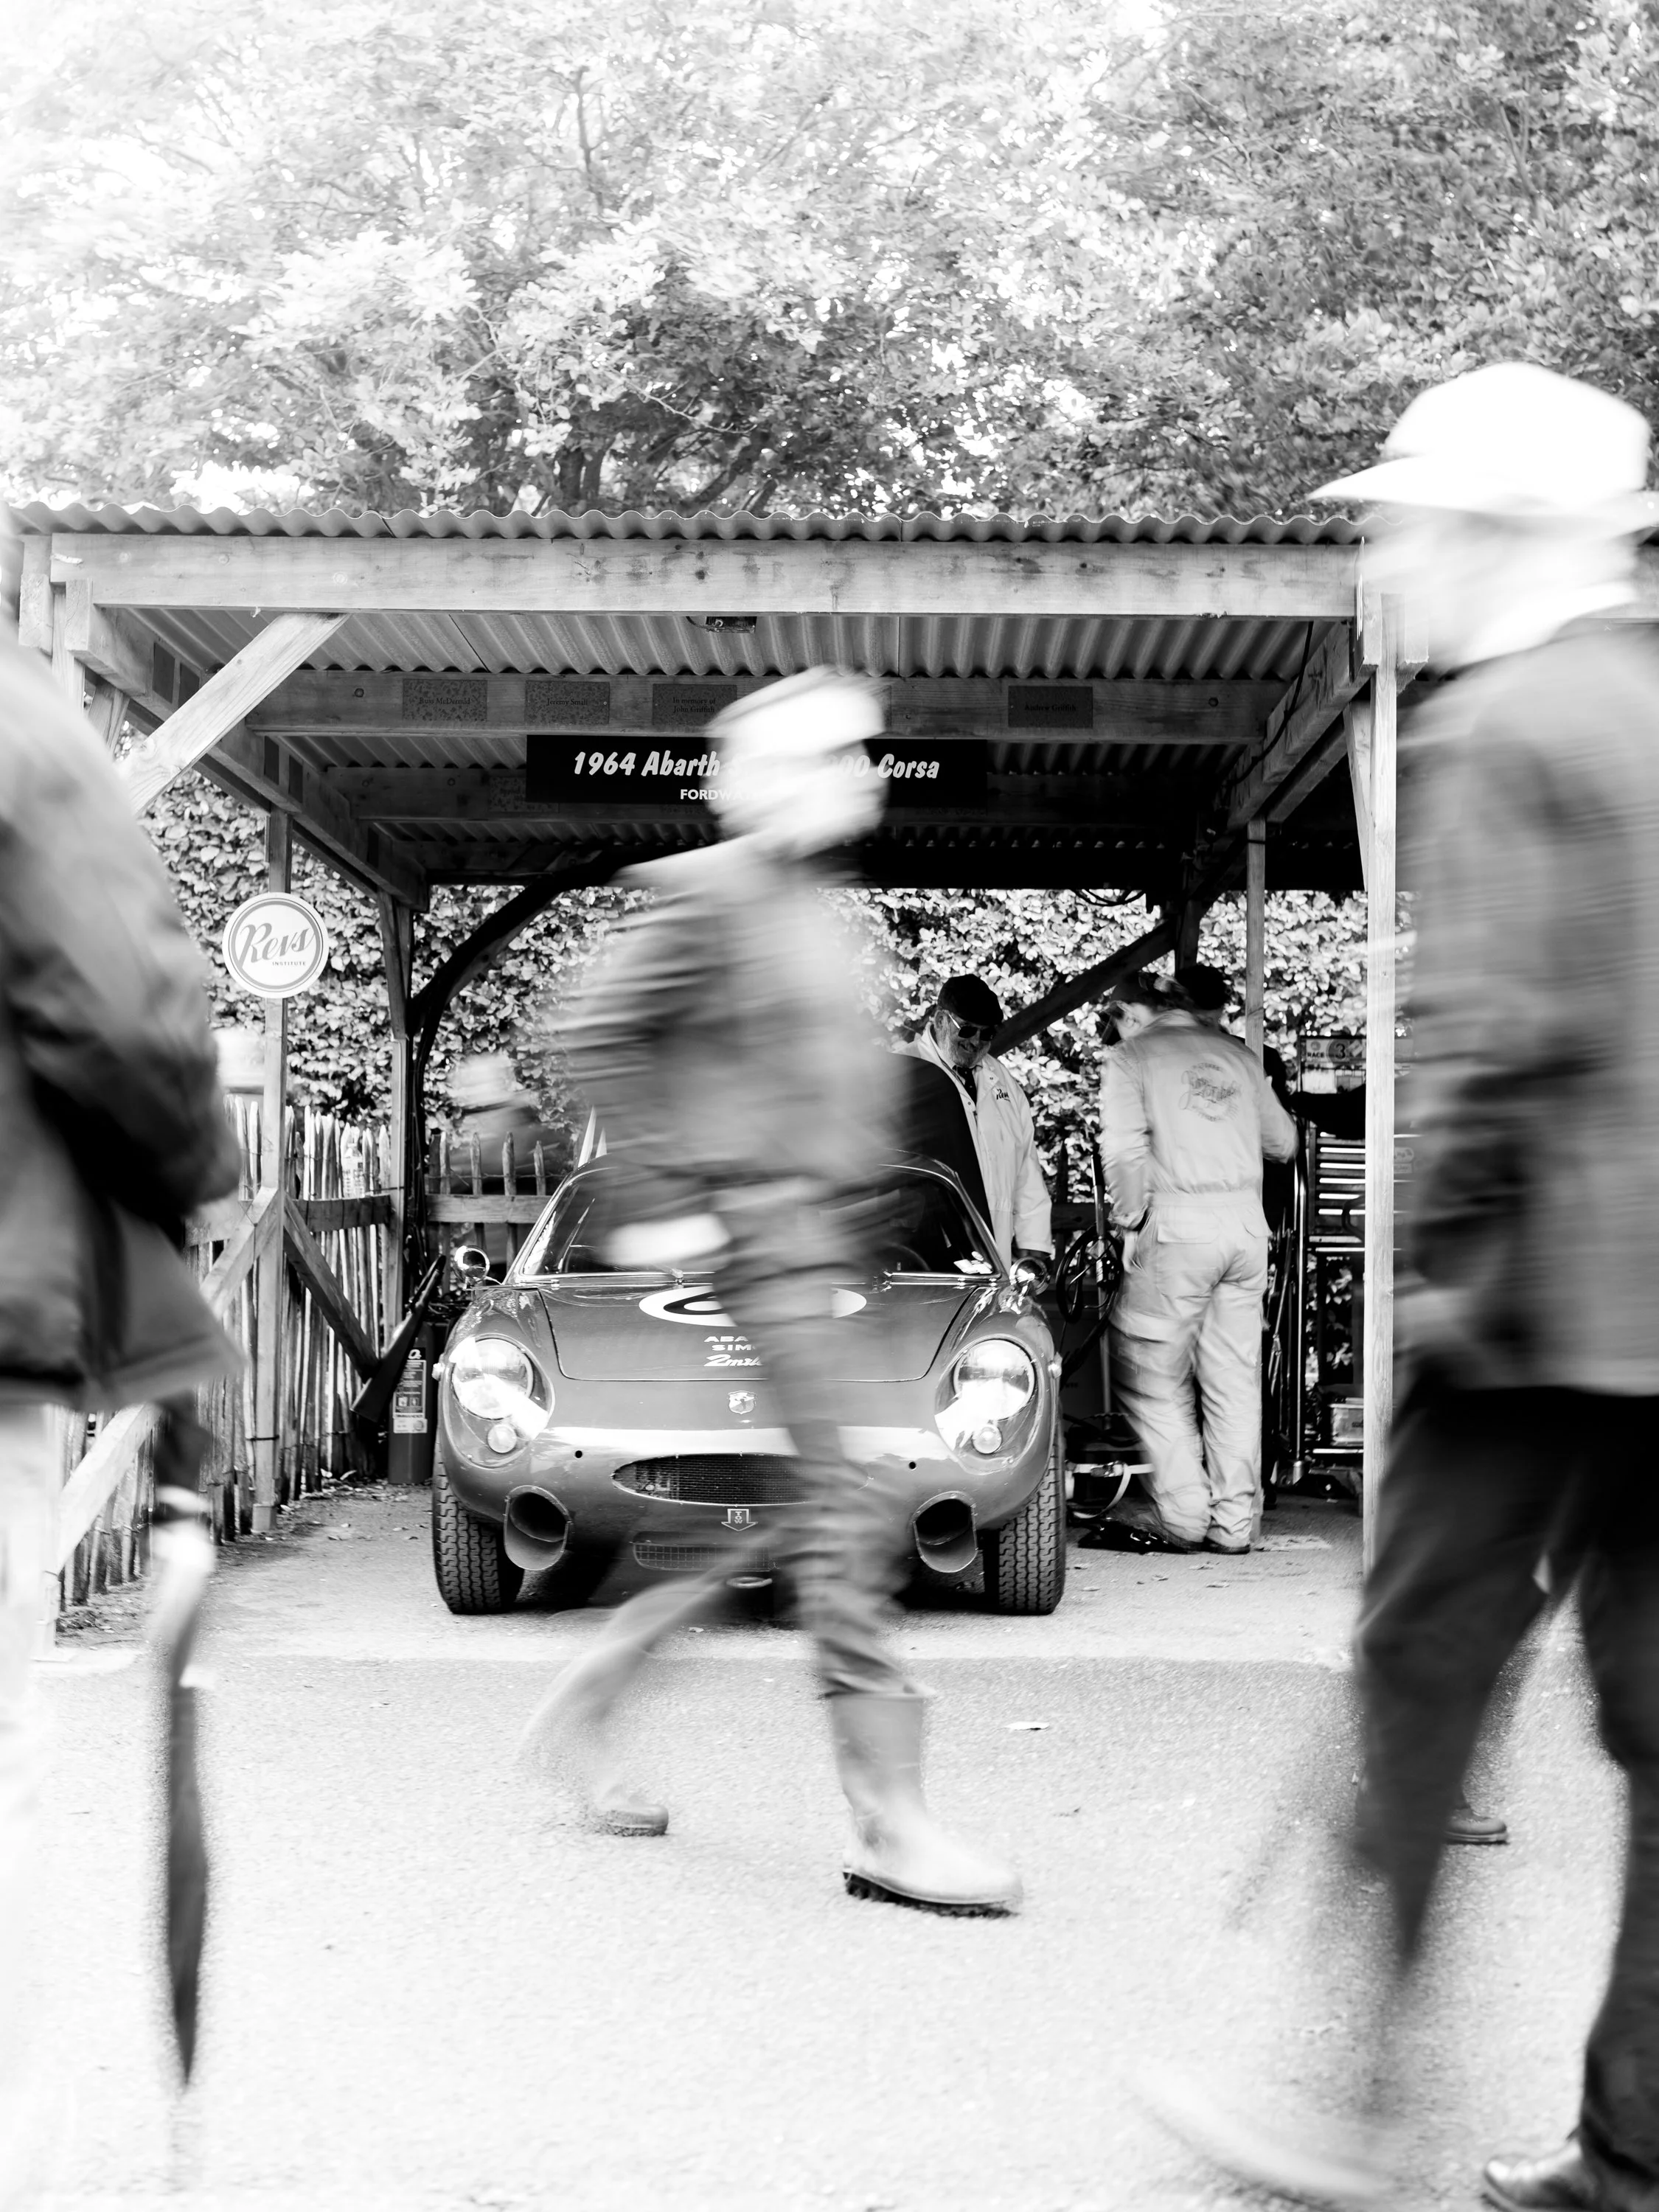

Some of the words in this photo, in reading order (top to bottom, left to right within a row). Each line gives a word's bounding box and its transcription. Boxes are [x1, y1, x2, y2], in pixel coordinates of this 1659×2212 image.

[419, 697, 434, 705] Russ
[436, 697, 470, 705] McDermid
[546, 698, 570, 707] Jeremy
[571, 698, 588, 706] Small
[681, 698, 707, 706] memory
[709, 697, 717, 705] of
[672, 706, 689, 714] John
[690, 706, 715, 714] Griffith
[574, 751, 636, 776] 1964
[641, 750, 720, 776] Abarth
[877, 753, 940, 779] Corsa
[238, 922, 316, 968] Revs
[1335, 1043, 1346, 1060] 3
[734, 1511, 742, 1524] TOW
